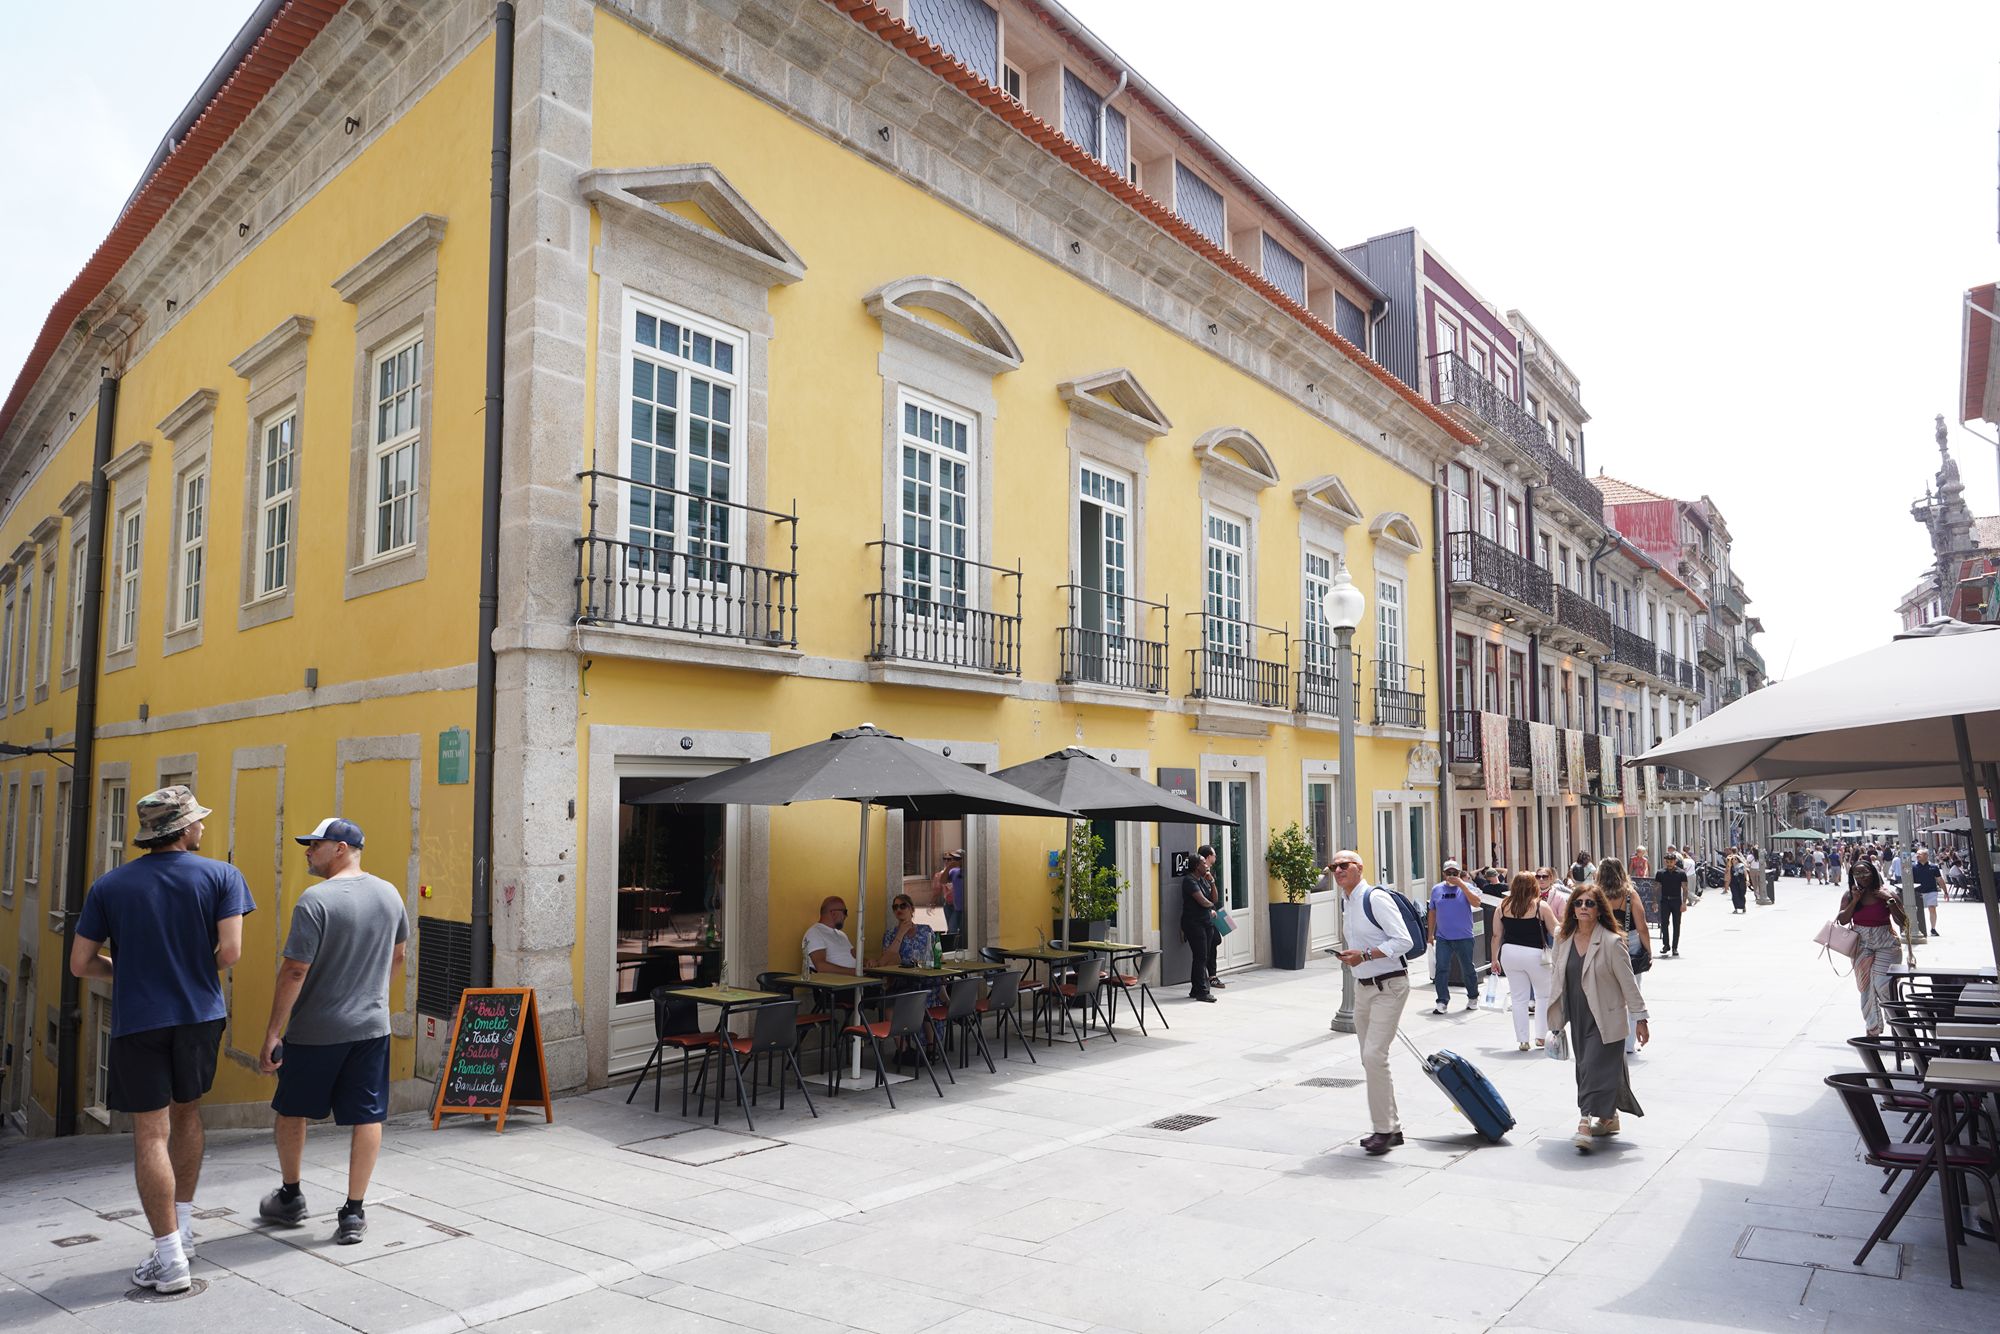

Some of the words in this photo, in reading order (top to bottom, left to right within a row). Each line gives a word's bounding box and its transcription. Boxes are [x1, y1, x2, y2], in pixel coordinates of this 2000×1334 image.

[682, 739, 692, 747] 102
[474, 1016, 509, 1030] Omelet
[472, 1030, 500, 1044] Toasts
[466, 1043, 499, 1059] Salads
[458, 1059, 495, 1076] Pancakes
[454, 1076, 504, 1093] Sandwiches
